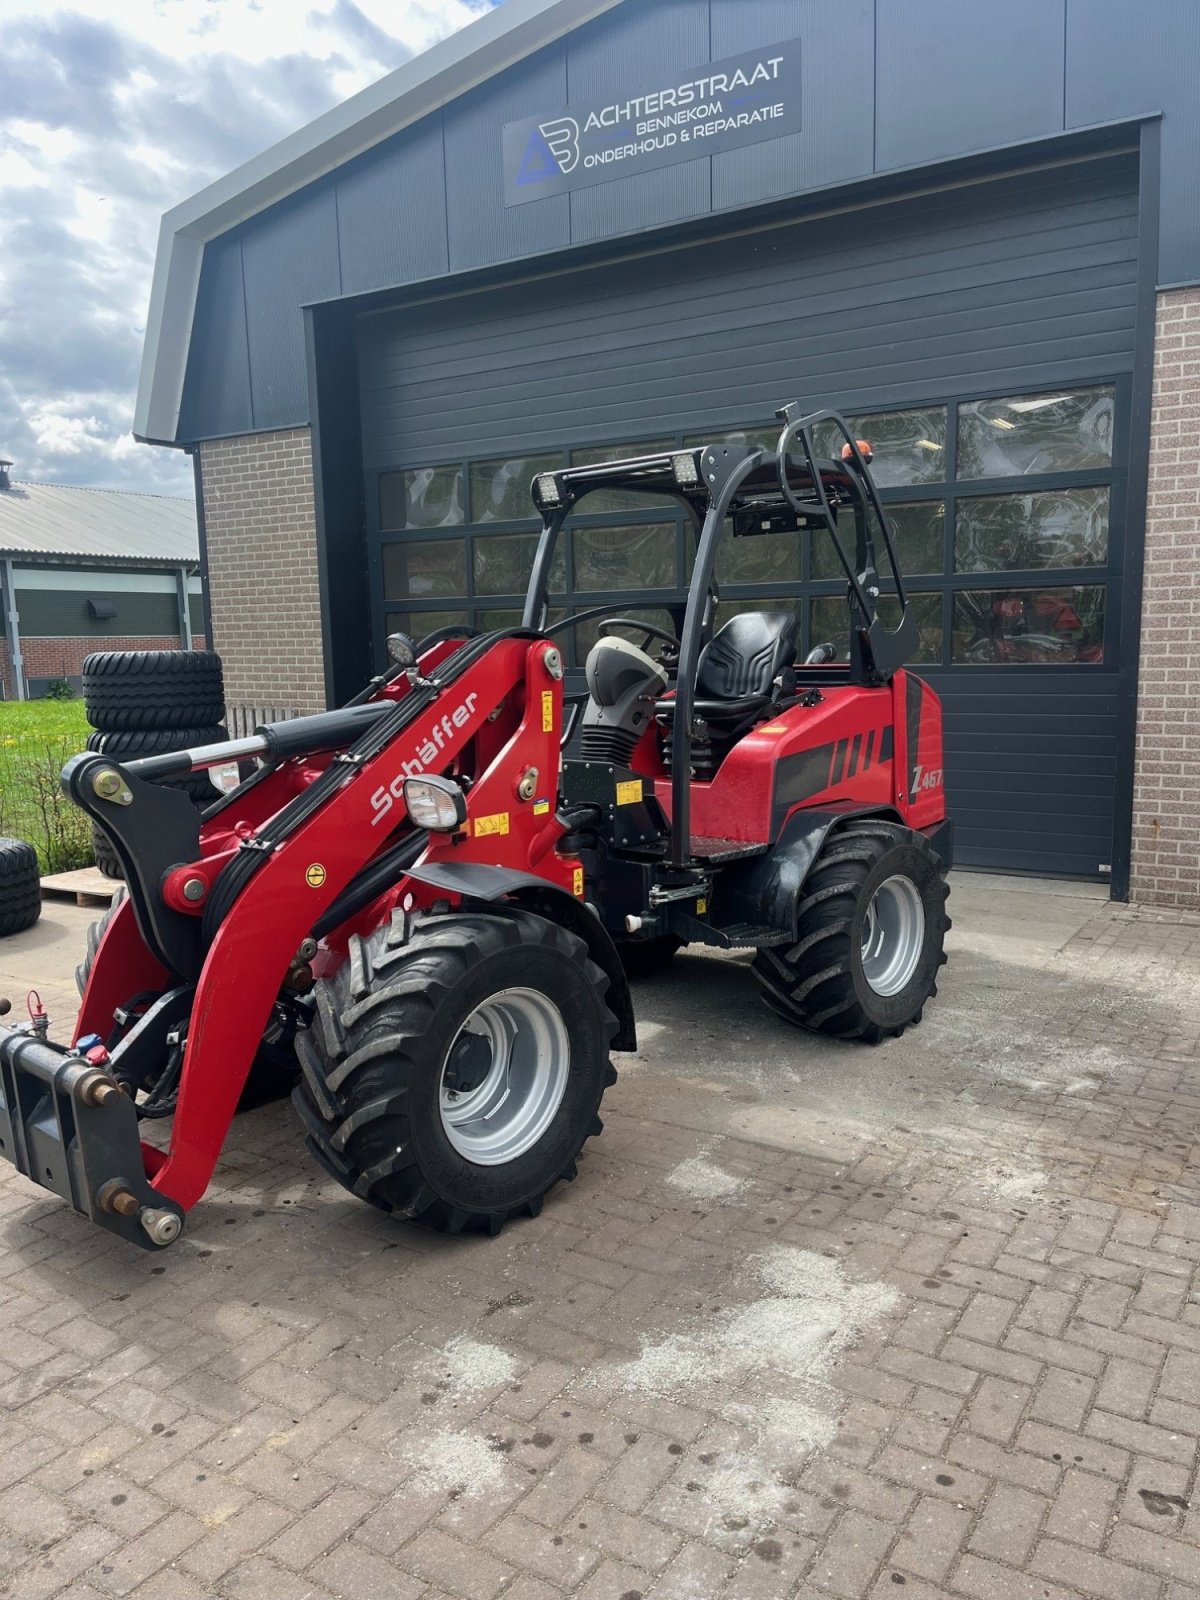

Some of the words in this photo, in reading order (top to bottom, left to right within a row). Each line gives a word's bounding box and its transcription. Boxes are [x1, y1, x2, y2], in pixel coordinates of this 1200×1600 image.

[583, 56, 784, 133] ACHTERSTRAAT
[635, 100, 723, 136] BENNEKOM
[583, 132, 677, 168] ONDERHOUD
[680, 129, 690, 142] &
[693, 103, 784, 139] REPARATIE
[369, 691, 478, 827] Schäffer
[910, 764, 944, 794] Z467
